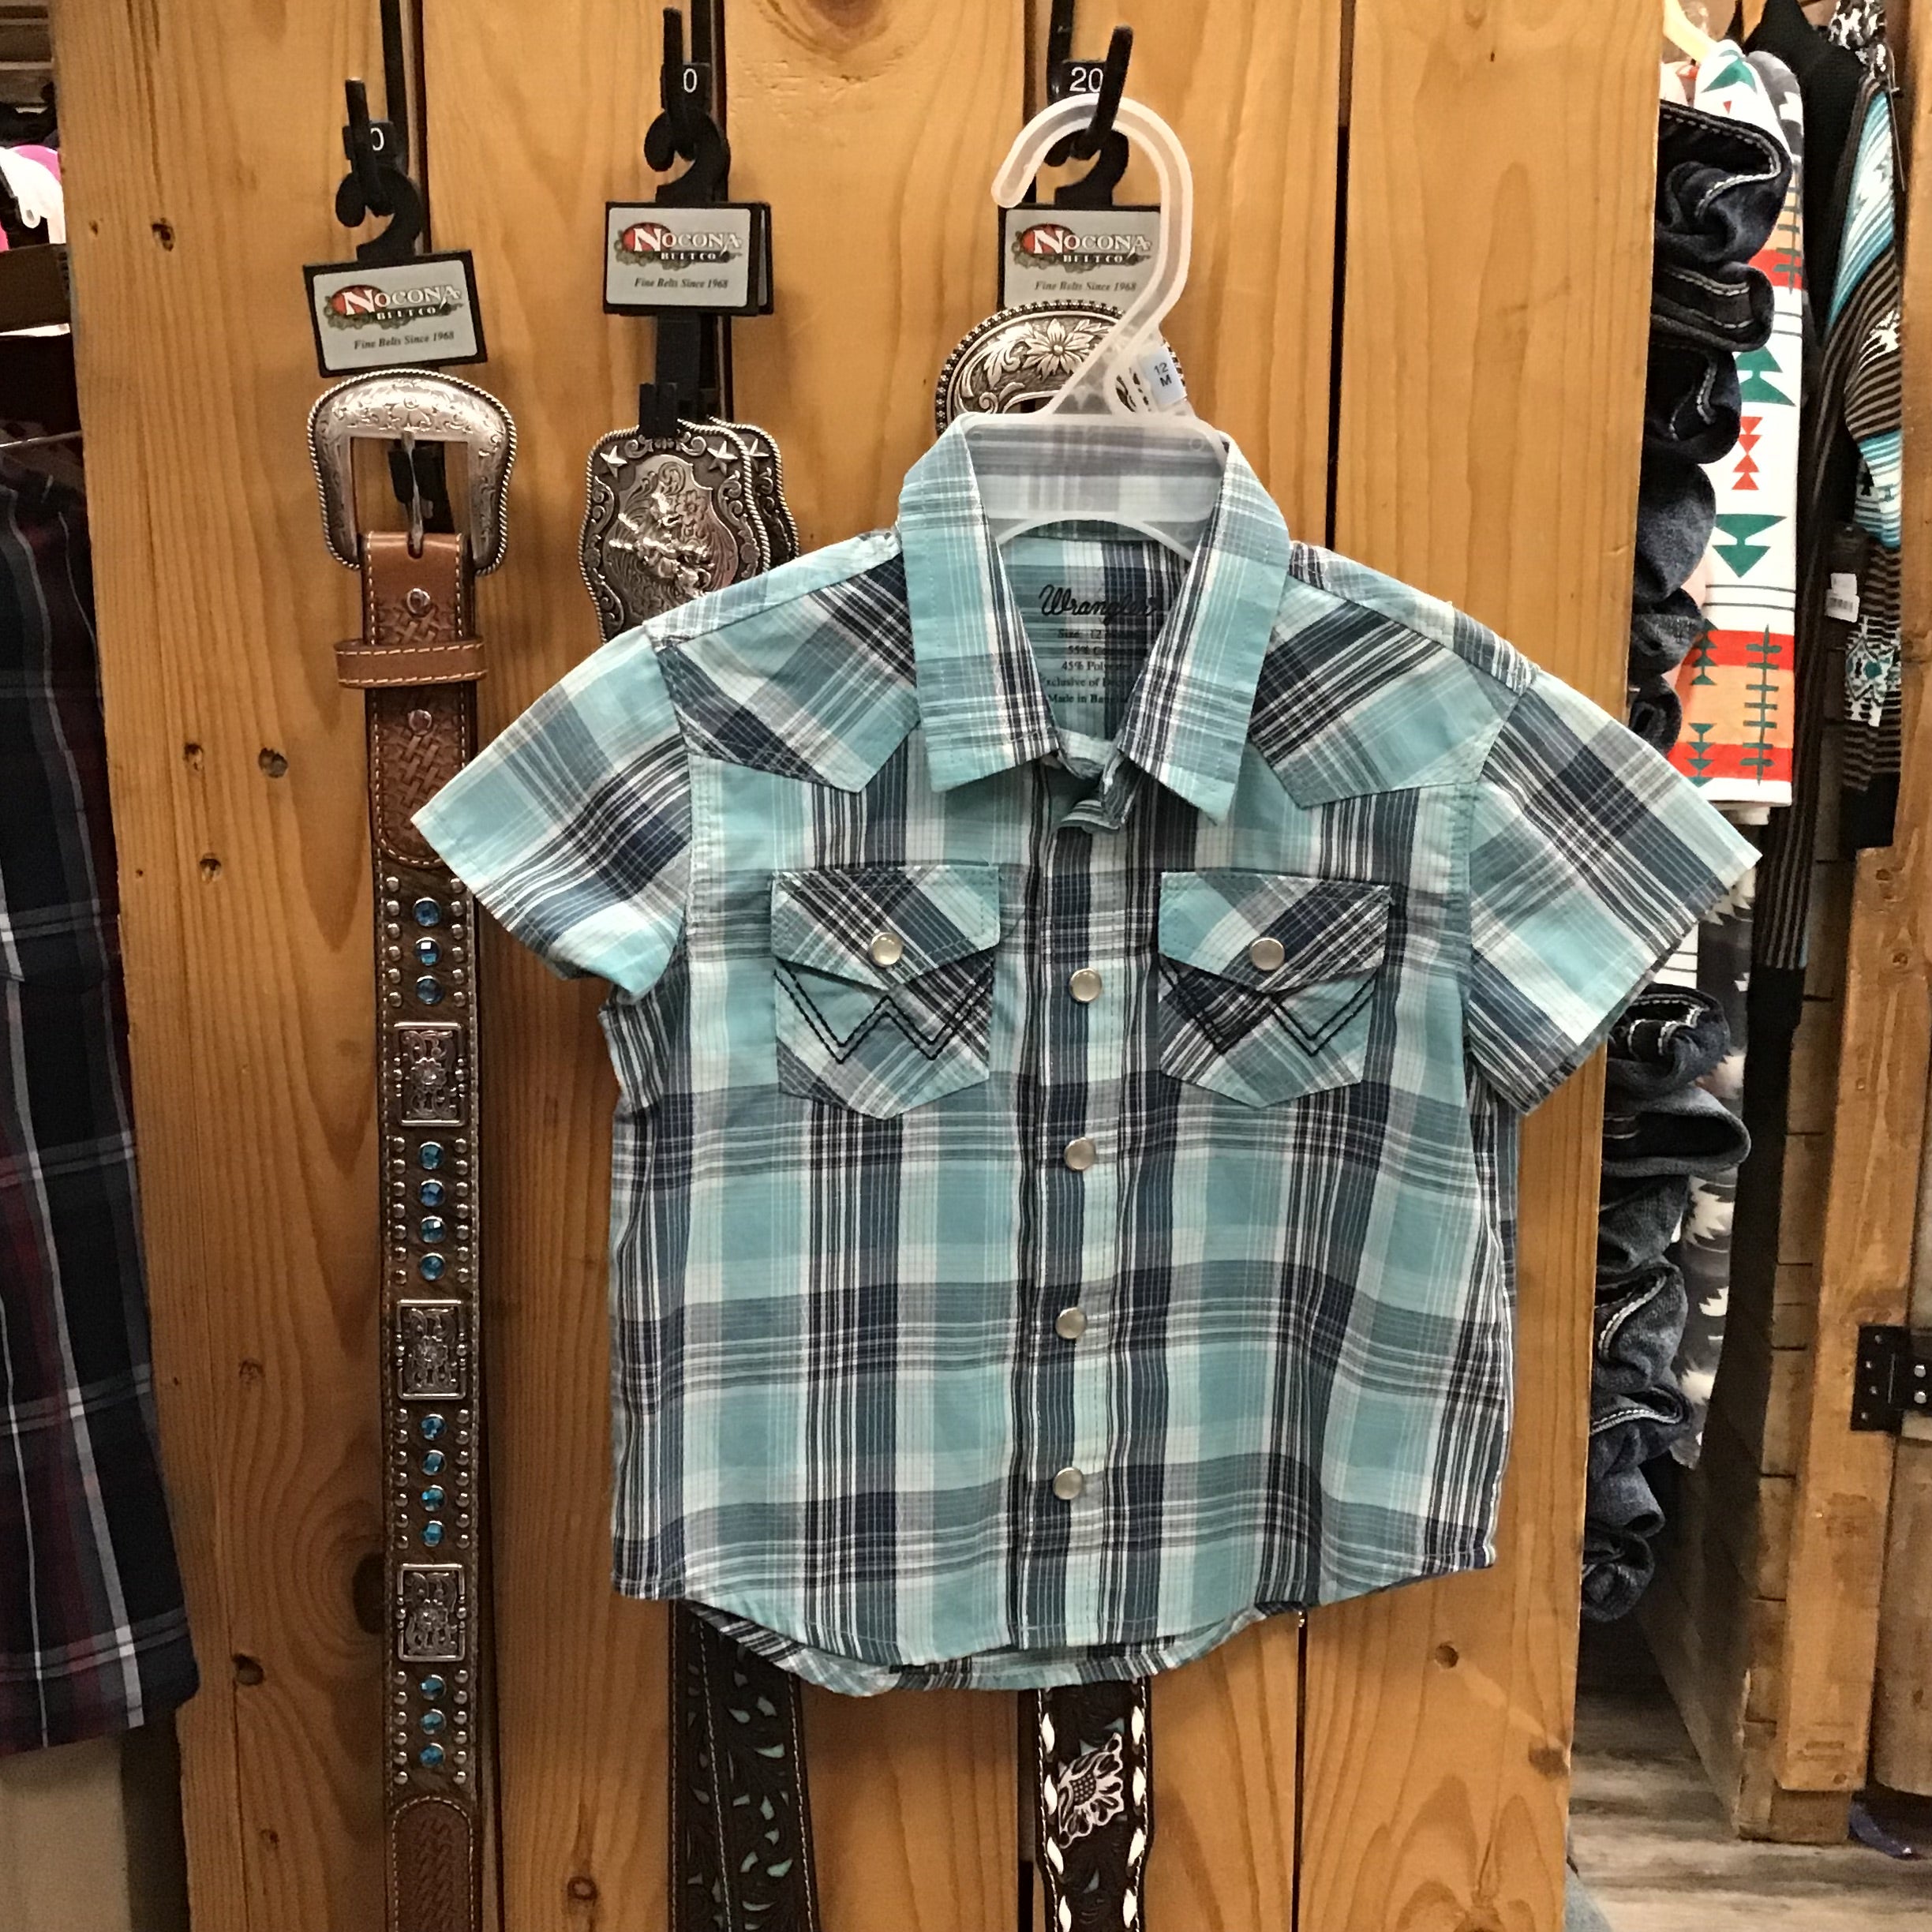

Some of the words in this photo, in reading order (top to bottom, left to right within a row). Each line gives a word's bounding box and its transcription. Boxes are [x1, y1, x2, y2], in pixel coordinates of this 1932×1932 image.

[1069, 66, 1103, 92] 20
[635, 278, 654, 288] Fine
[657, 278, 679, 288] Belts
[681, 279, 705, 289] Since
[707, 279, 728, 289] 1968
[1035, 280, 1057, 291] Fine
[1059, 281, 1083, 291] Belts
[1086, 281, 1110, 291] Since
[1114, 282, 1137, 291] 1968
[354, 339, 376, 350] Fine
[378, 337, 402, 348] Belts
[404, 334, 429, 345] Since
[432, 331, 455, 343] 1968
[1154, 362, 1169, 375] 12
[1159, 374, 1172, 387] M
[1039, 584, 1157, 625] Wrangler
[1062, 661, 1084, 670] 45%
[1048, 694, 1074, 703] Made
[1077, 694, 1087, 703] in
